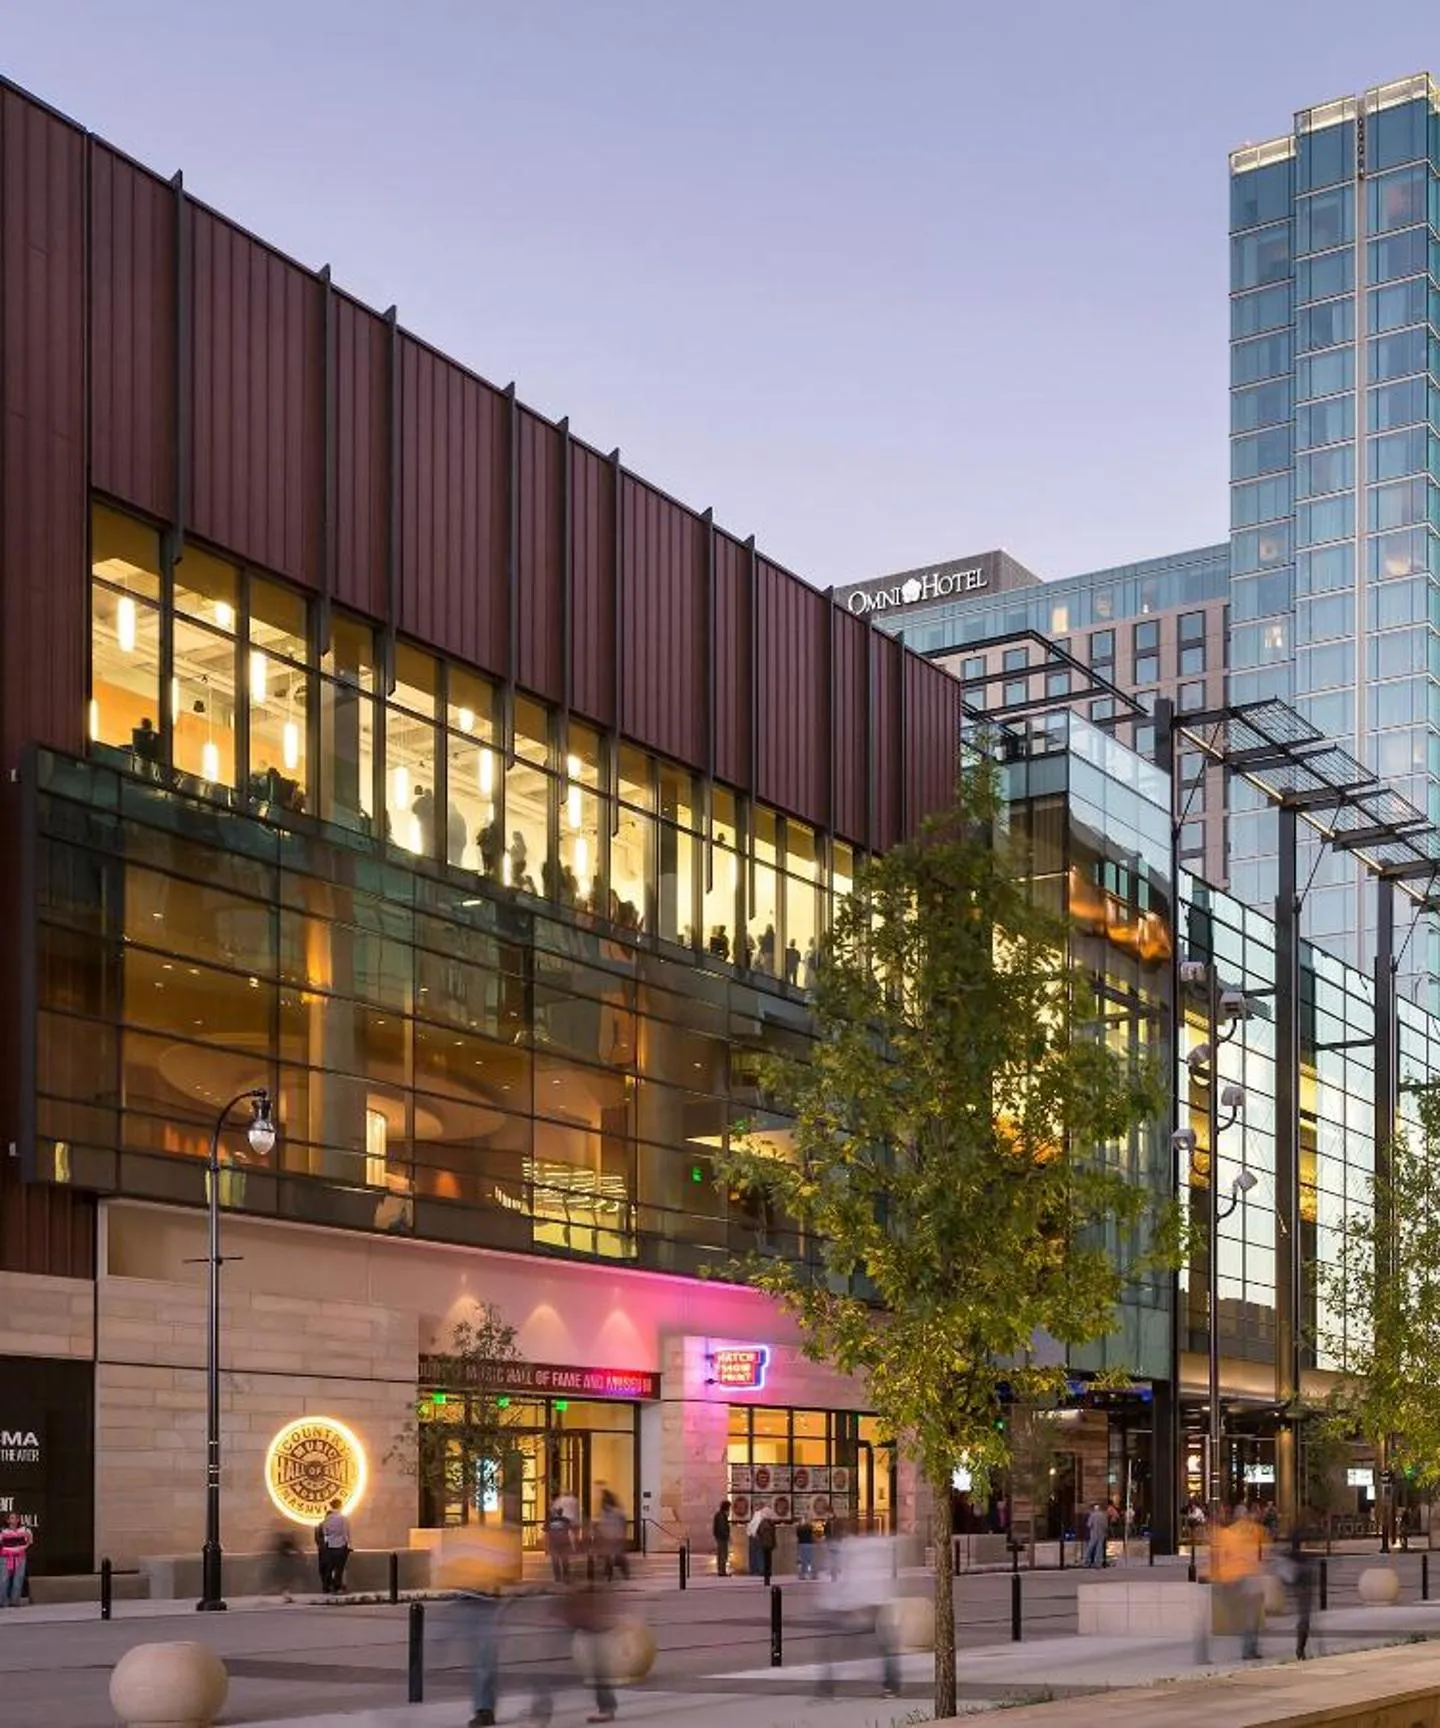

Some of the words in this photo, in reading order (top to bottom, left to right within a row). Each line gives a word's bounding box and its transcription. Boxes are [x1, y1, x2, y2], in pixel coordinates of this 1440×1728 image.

[848, 587, 901, 615] OMNI
[921, 568, 987, 600] HOTEL
[535, 1370, 550, 1386] OF
[552, 1371, 581, 1388] FAME
[0, 1430, 39, 1446] MA
[292, 1440, 338, 1458] MUSIC
[276, 1455, 306, 1485] HALL
[308, 1466, 322, 1475] OF
